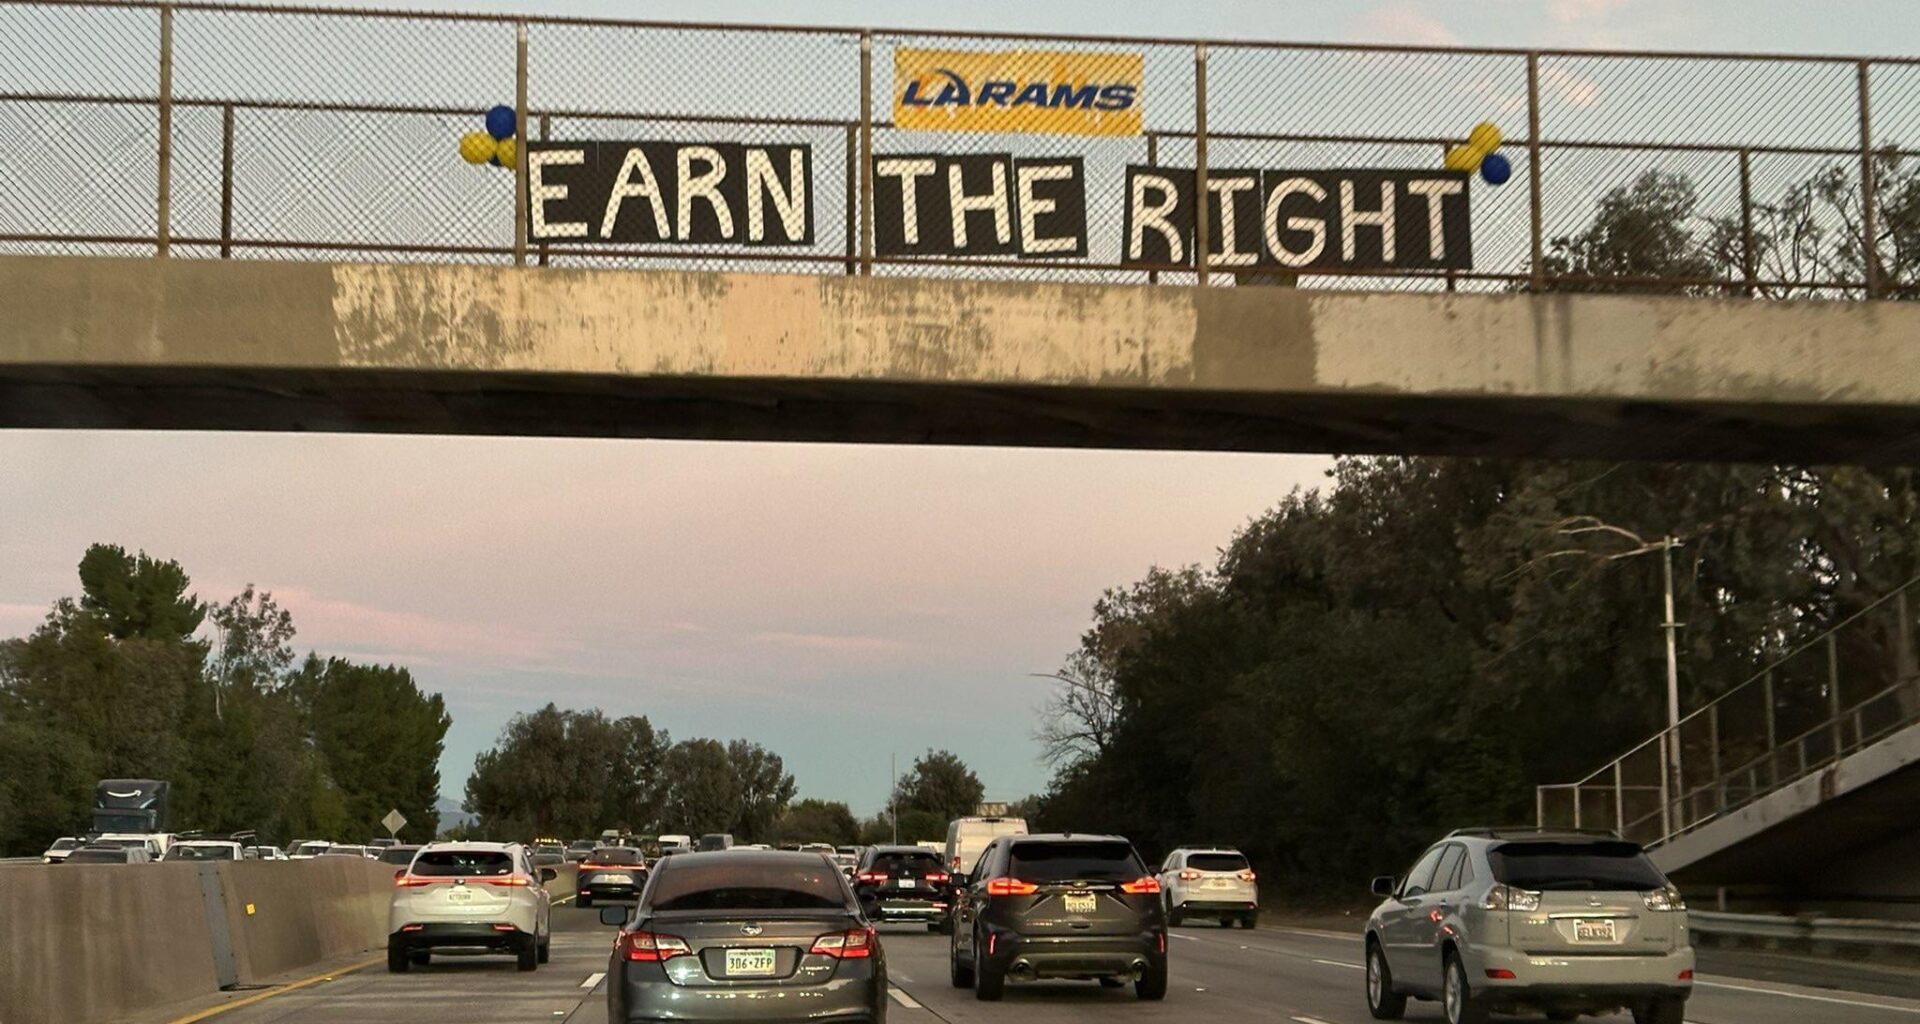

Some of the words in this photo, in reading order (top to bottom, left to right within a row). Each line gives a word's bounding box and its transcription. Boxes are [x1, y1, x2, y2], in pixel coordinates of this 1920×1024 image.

[901, 67, 971, 107] LA
[977, 81, 1137, 112] RAMS
[529, 147, 804, 241] EARN
[878, 159, 1077, 254] THE
[1129, 175, 1463, 268] RIGHT
